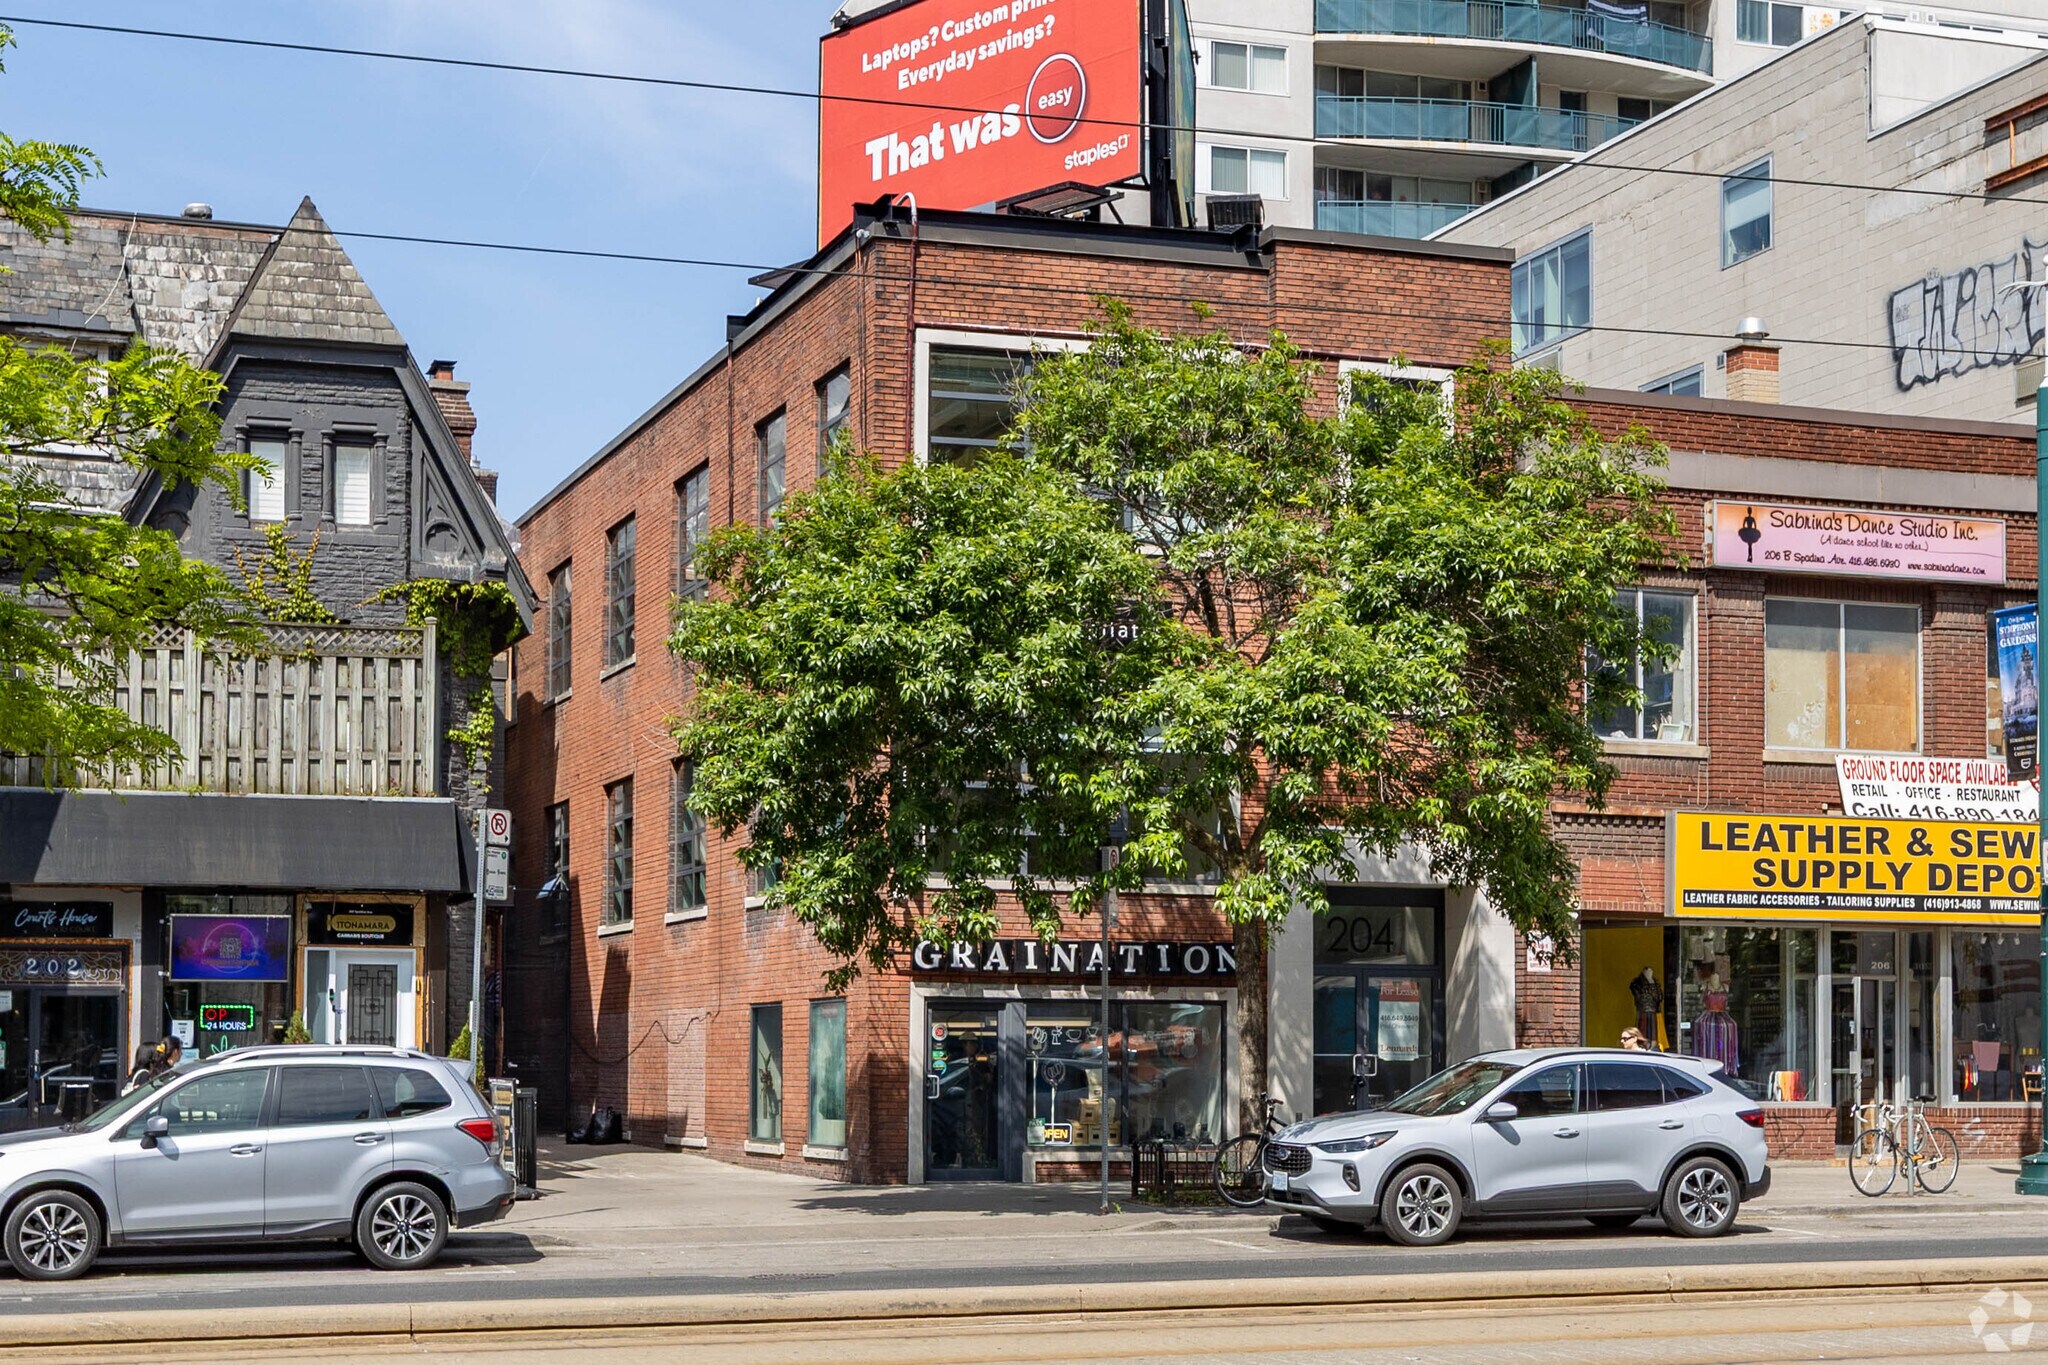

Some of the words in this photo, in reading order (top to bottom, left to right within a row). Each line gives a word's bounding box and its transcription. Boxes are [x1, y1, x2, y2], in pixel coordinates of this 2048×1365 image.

[861, 26, 939, 73] Laptops?
[941, 4, 1009, 42] Custom
[1011, 0, 1055, 22] prin
[897, 48, 976, 90] Everyday
[978, 14, 1055, 61] savings?
[1038, 86, 1073, 110] easy
[865, 121, 945, 182] That
[949, 103, 1021, 155] was
[1064, 142, 1118, 171] staples
[1770, 510, 1843, 532] Sabrina's
[1845, 513, 1895, 536] Dance
[1899, 518, 1948, 539] Studio
[1953, 520, 1979, 541] Inc.
[1834, 536, 1854, 546] dance
[1857, 537, 1879, 548] school
[1764, 550, 1781, 561] 206
[1783, 550, 1791, 561] B
[1794, 552, 1825, 564] Spadina
[2000, 634, 2037, 648] GARDENS
[1842, 758, 1887, 782] GROUND
[1890, 761, 1926, 784] FLOOR
[1929, 762, 1962, 785] SPACE
[1965, 763, 2018, 787] AVAILAB
[1852, 784, 1888, 797] RETAIL
[1905, 786, 1941, 800] OFFICE
[1956, 788, 2021, 802] RESTAURANT
[1852, 802, 1900, 818] Call:
[1701, 821, 1891, 856] LEATHER
[1906, 827, 1934, 857] &
[1949, 829, 2040, 859] SEW
[1753, 858, 1912, 891] SUPPLY
[1928, 863, 2040, 893] DEPO
[1685, 892, 1725, 904] LEATHER
[1726, 894, 1758, 905] FABRIC
[1760, 895, 1820, 906] ACCESSORIES
[1826, 896, 1872, 908] TAILORING
[1874, 898, 1915, 908] SUPPLIES
[1923, 898, 1982, 911] (416)913-4868
[1989, 900, 2040, 911] WWW.SEWIN
[59, 908, 98, 926] House
[336, 921, 390, 930] ITONAMARA
[1327, 916, 1394, 953] 204
[26, 957, 80, 975] 202
[913, 940, 1236, 974] GRAINATION
[1871, 961, 1890, 970] 206
[1380, 986, 1394, 996] For
[1396, 986, 1419, 996] Lease
